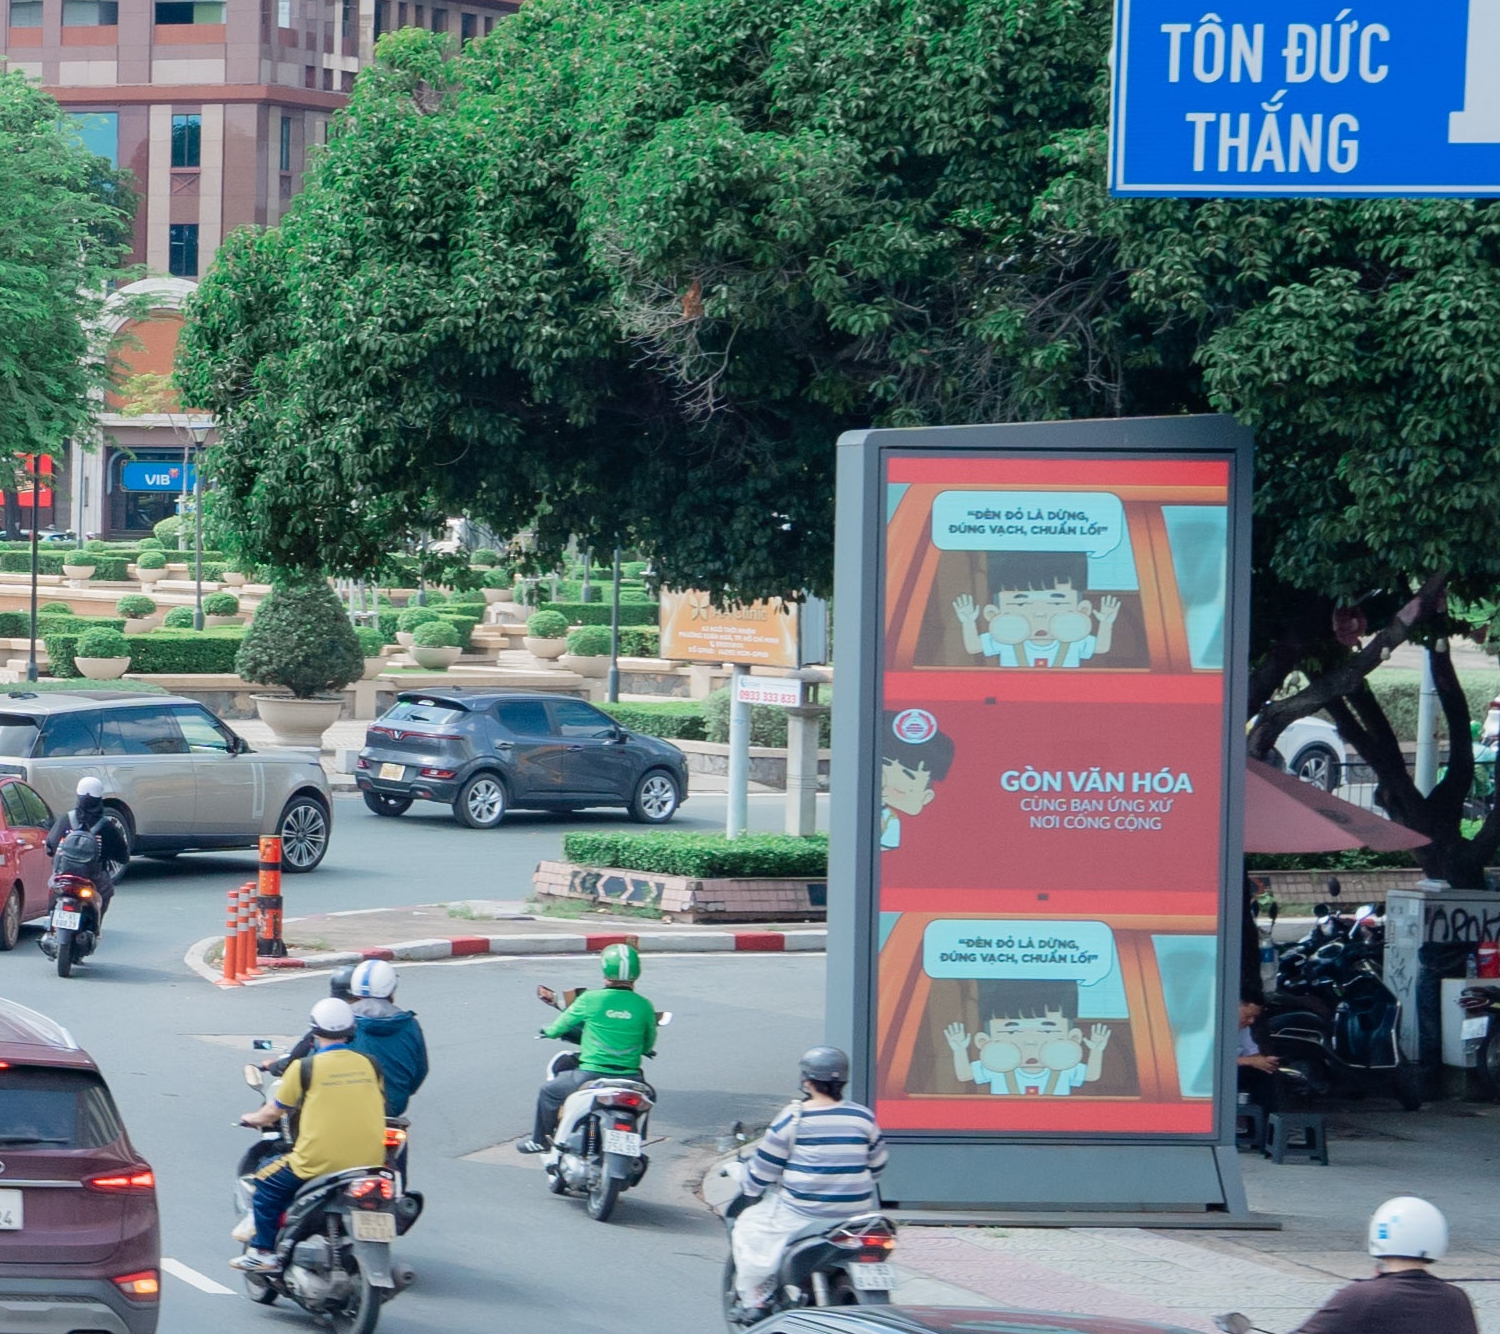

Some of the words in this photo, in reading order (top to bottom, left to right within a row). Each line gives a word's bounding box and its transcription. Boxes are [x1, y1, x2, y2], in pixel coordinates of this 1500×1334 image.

[1160, 12, 1265, 84] TÔN
[1281, 8, 1391, 84] ĐỨC
[1185, 89, 1360, 174] THẮNG
[144, 473, 171, 486] VIB
[1005, 506, 1024, 521] ĐỎ
[1027, 508, 1045, 521] LÀ
[948, 522, 986, 534] ĐÚNG
[989, 524, 1028, 537] VẠCH,
[1000, 765, 1063, 792] GÒN
[1067, 766, 1125, 793] VĂN
[1132, 767, 1194, 794] HÓA
[1020, 795, 1067, 812] CÙNG
[1107, 796, 1145, 813] ỨNG
[1029, 815, 1060, 829] NƠI
[1114, 813, 1163, 833] CỘNG
[995, 935, 1015, 948] ĐỎ
[1018, 936, 1034, 949] LÀ
[939, 950, 977, 962] ĐÚNG
[980, 952, 1019, 965] VẠCH,
[605, 1009, 632, 1020] Grab
